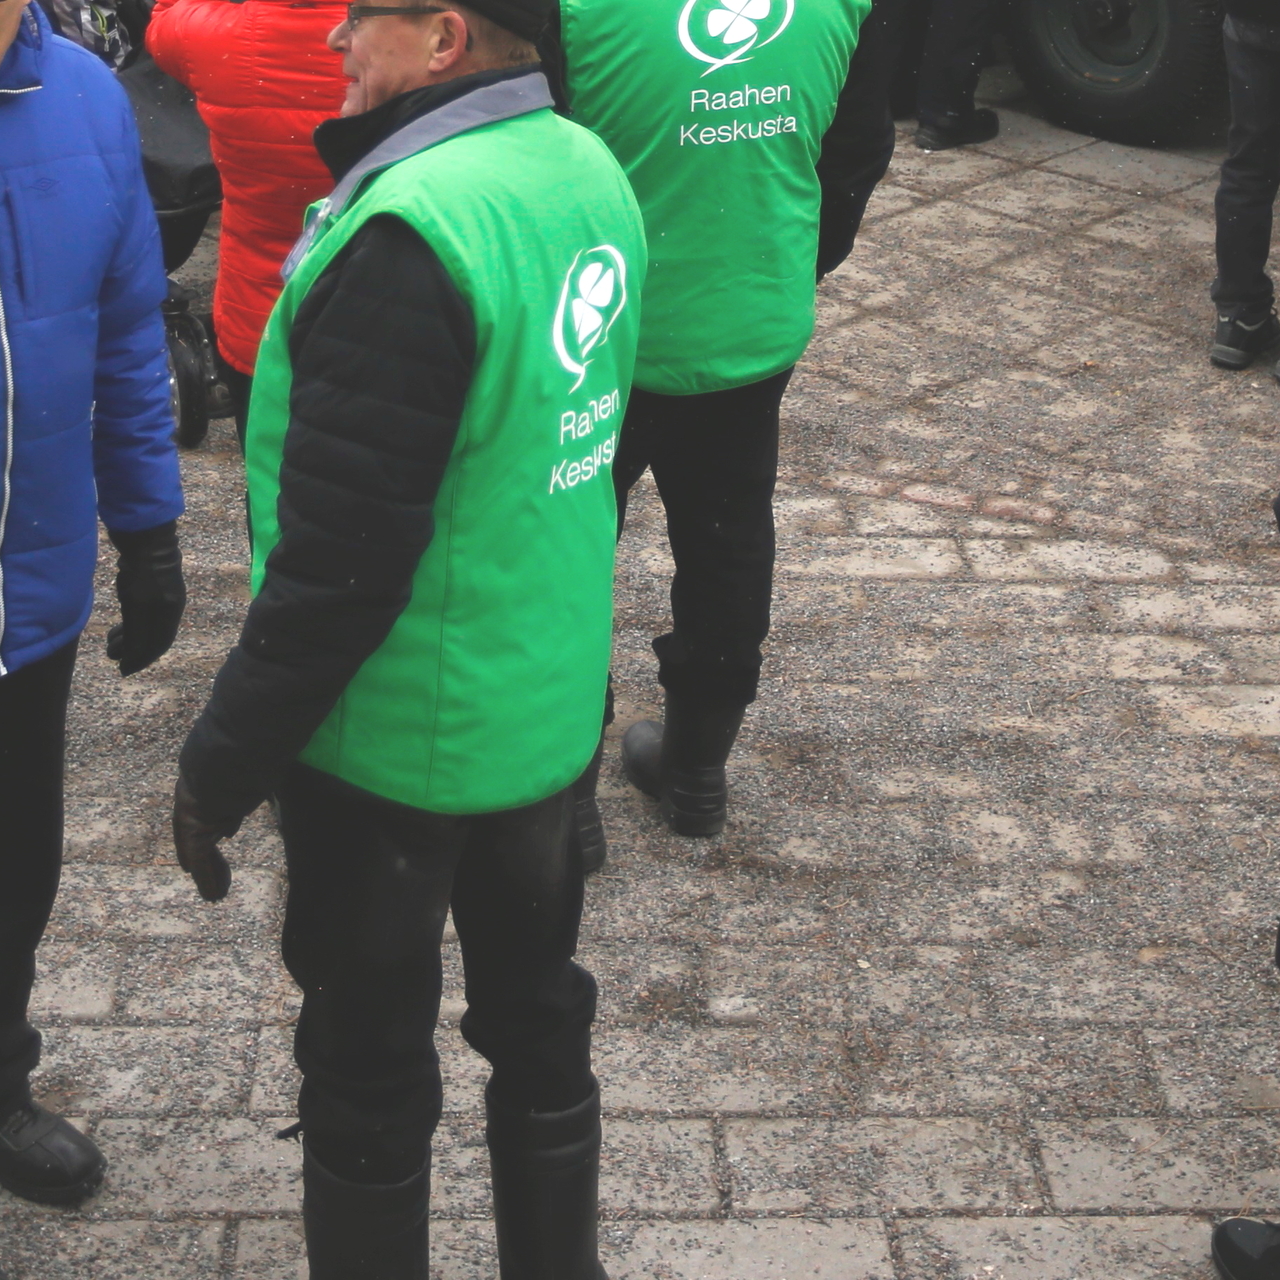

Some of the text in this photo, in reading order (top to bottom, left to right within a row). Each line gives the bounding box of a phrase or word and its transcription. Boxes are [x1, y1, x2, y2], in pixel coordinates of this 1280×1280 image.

[690, 84, 791, 112] Raahen
[680, 114, 797, 146] Keskusta
[560, 389, 619, 445] Rahen
[549, 430, 616, 495] Keskust
